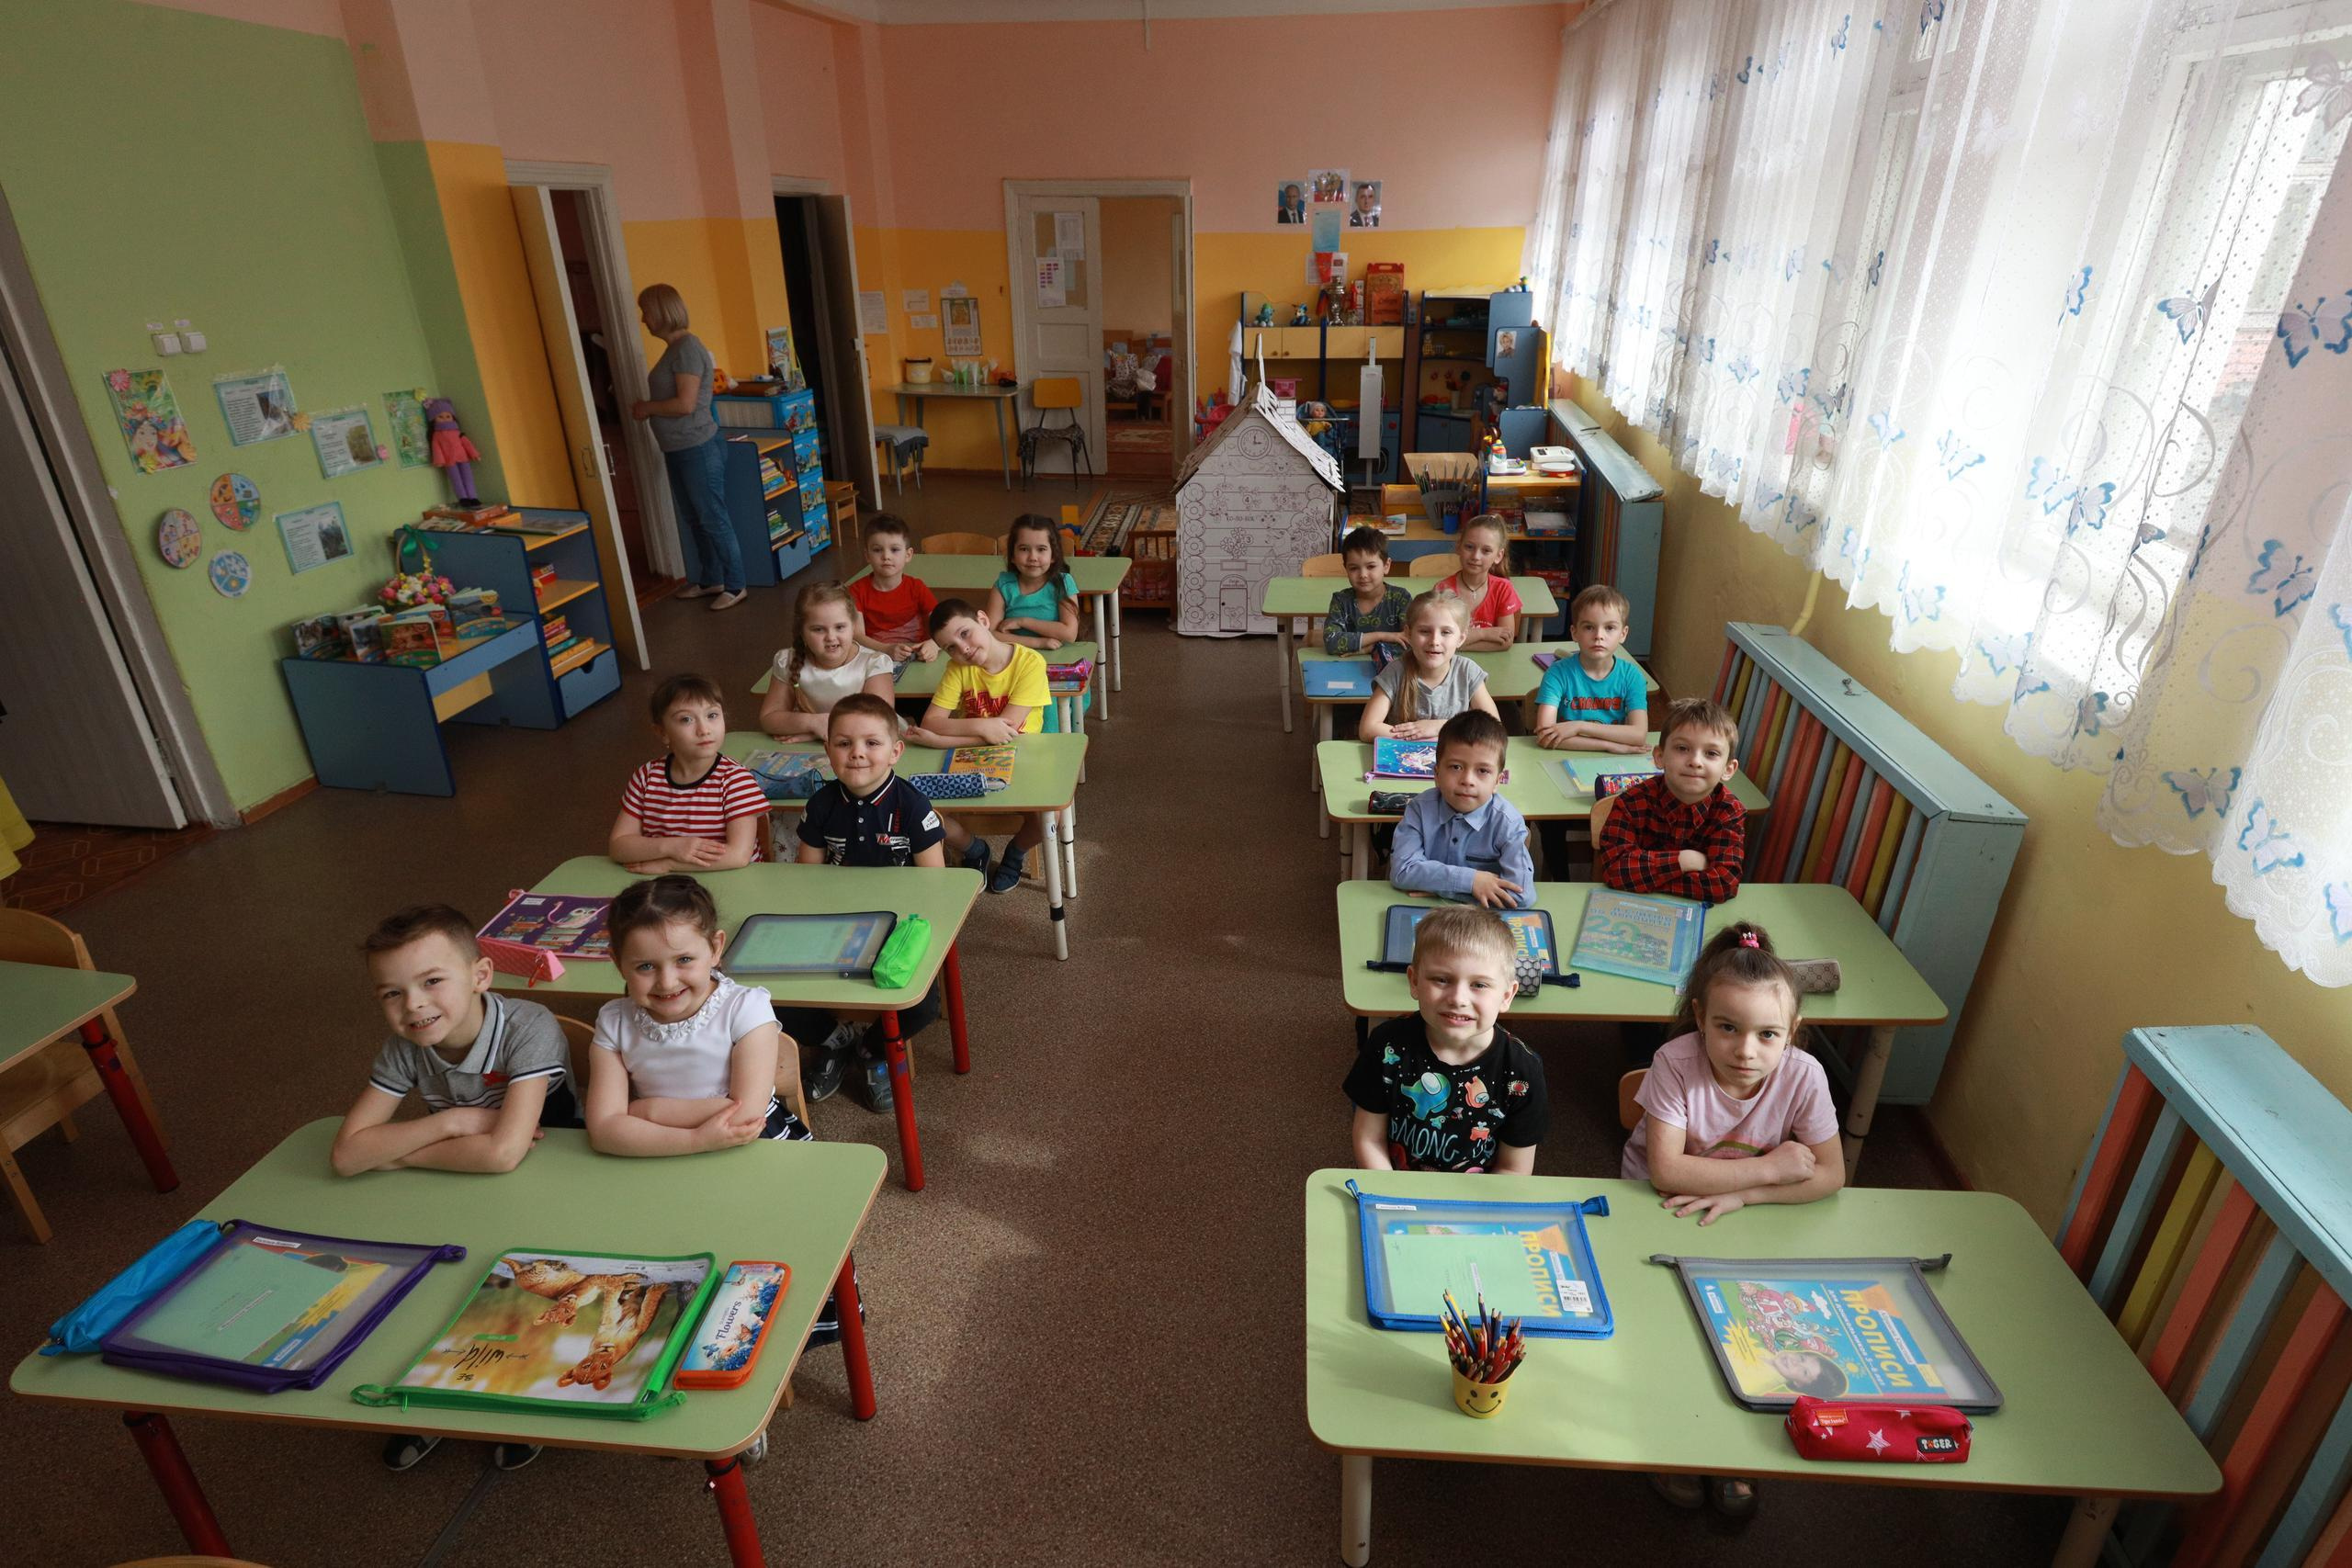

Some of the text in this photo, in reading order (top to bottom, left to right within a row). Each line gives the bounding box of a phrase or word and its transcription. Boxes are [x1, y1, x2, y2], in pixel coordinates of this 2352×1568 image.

[1571, 696, 1622, 710] CHAMPS
[1519, 1230, 1562, 1317] ПРОПИСИ
[715, 1300, 742, 1340] Flowers
[1839, 1289, 1914, 1387] ПРОПИСИ
[454, 1344, 504, 1370] wild
